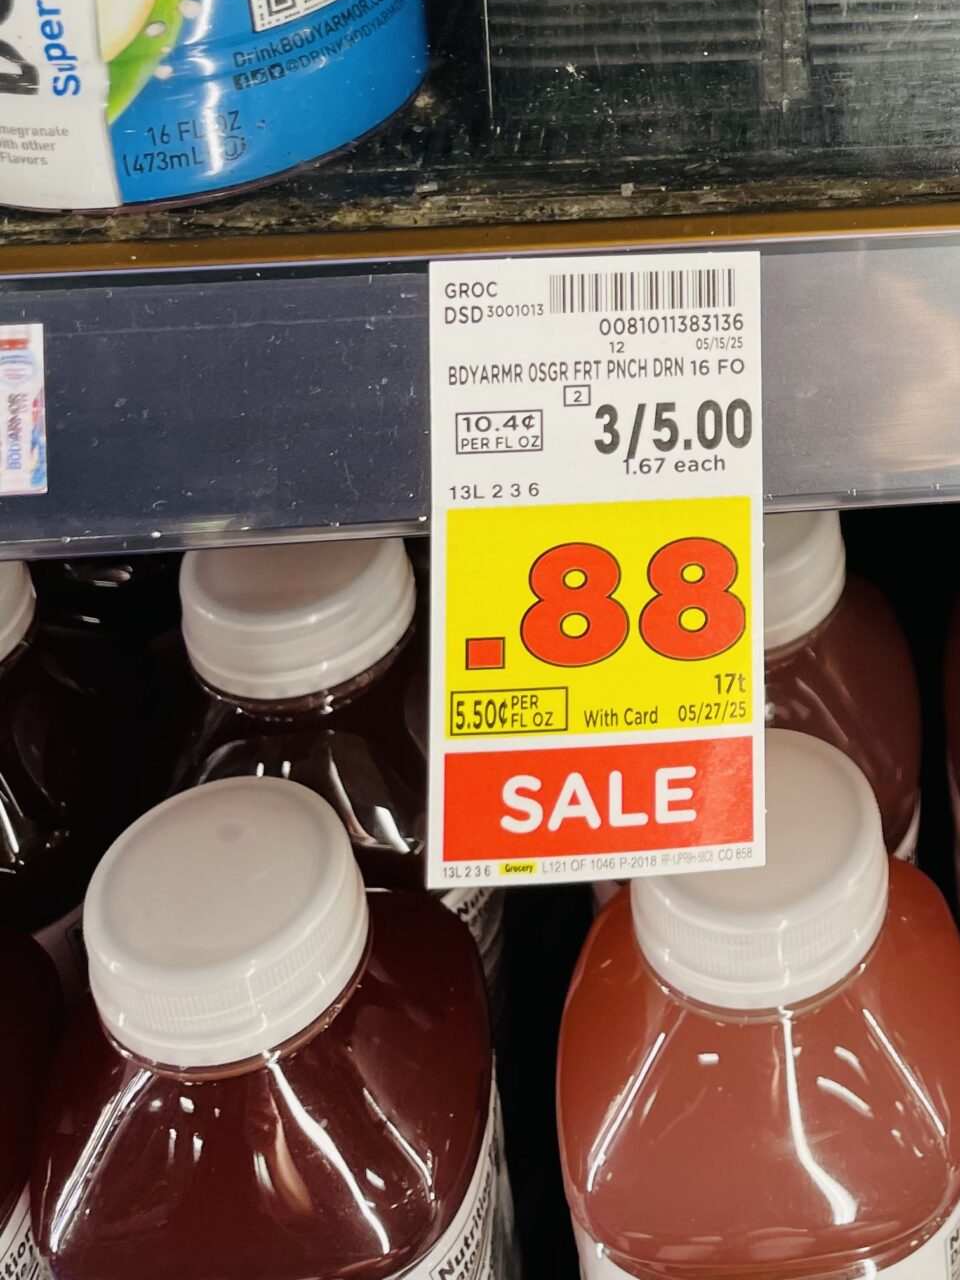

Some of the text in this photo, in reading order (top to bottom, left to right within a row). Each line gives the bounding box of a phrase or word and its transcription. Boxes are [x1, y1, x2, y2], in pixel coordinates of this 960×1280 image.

[22, 141, 55, 151] other
[148, 126, 170, 146] 16
[445, 282, 498, 298] GROC
[445, 304, 544, 324] DSD 3001013
[599, 314, 743, 336] 0081011383136
[696, 338, 743, 350] 05/15/25
[449, 357, 745, 385] BDYARMR OSGR FRT PNCH DRN 16 FO
[462, 399, 752, 459] 10.4¢ 3/5.00
[461, 435, 540, 450] PER FL OZ
[624, 456, 725, 475] 1.67 each
[449, 483, 539, 500] 13L 2 3 6
[465, 536, 746, 670] .88
[714, 674, 745, 694] 17t
[456, 695, 538, 730] 5.50¢ PER
[511, 712, 553, 728] FL OZ
[584, 701, 746, 727] With Card 05/27/25
[500, 765, 697, 834] SALE
[505, 863, 533, 873] Grocery
[543, 861, 567, 873] L121
[571, 859, 586, 871] OF
[591, 858, 615, 870] 1046
[619, 856, 656, 868] P-2018
